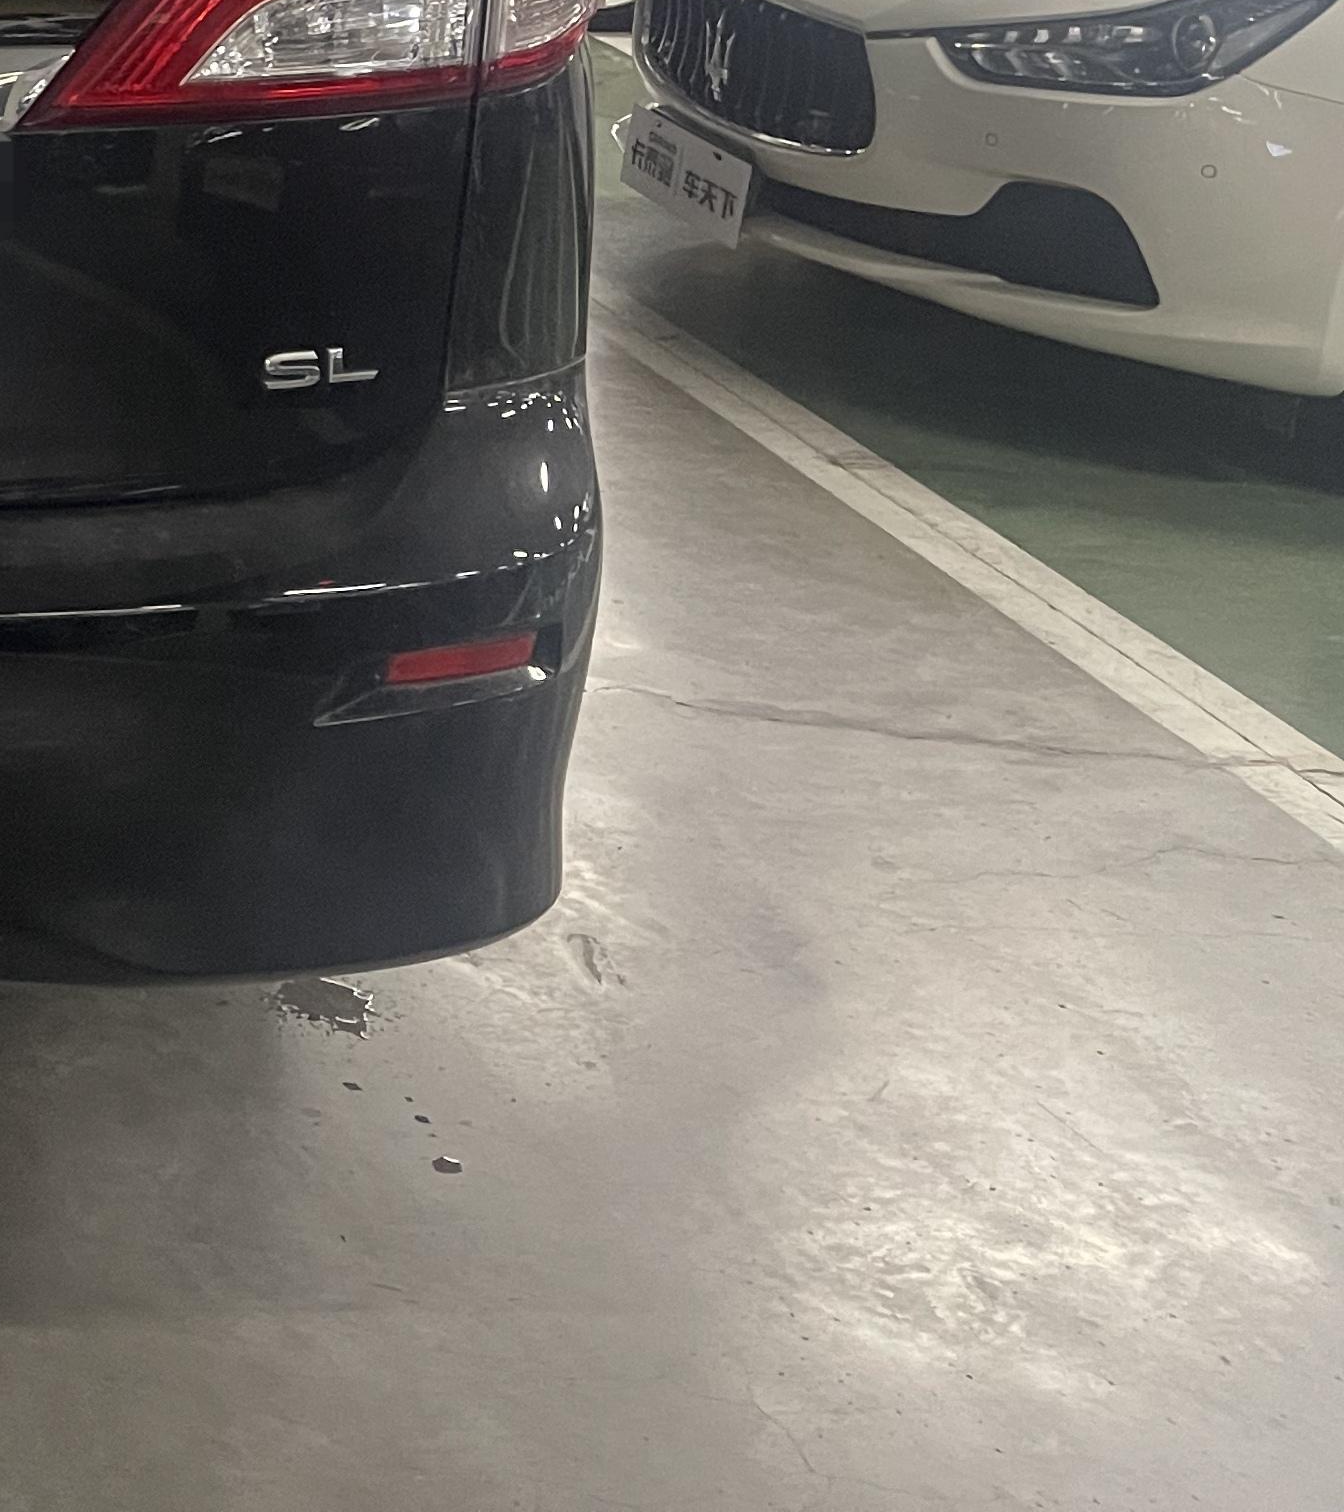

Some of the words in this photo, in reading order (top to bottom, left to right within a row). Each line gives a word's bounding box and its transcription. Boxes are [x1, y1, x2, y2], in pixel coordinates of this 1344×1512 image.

[681, 169, 739, 219] 车天下
[264, 347, 380, 390] SL
